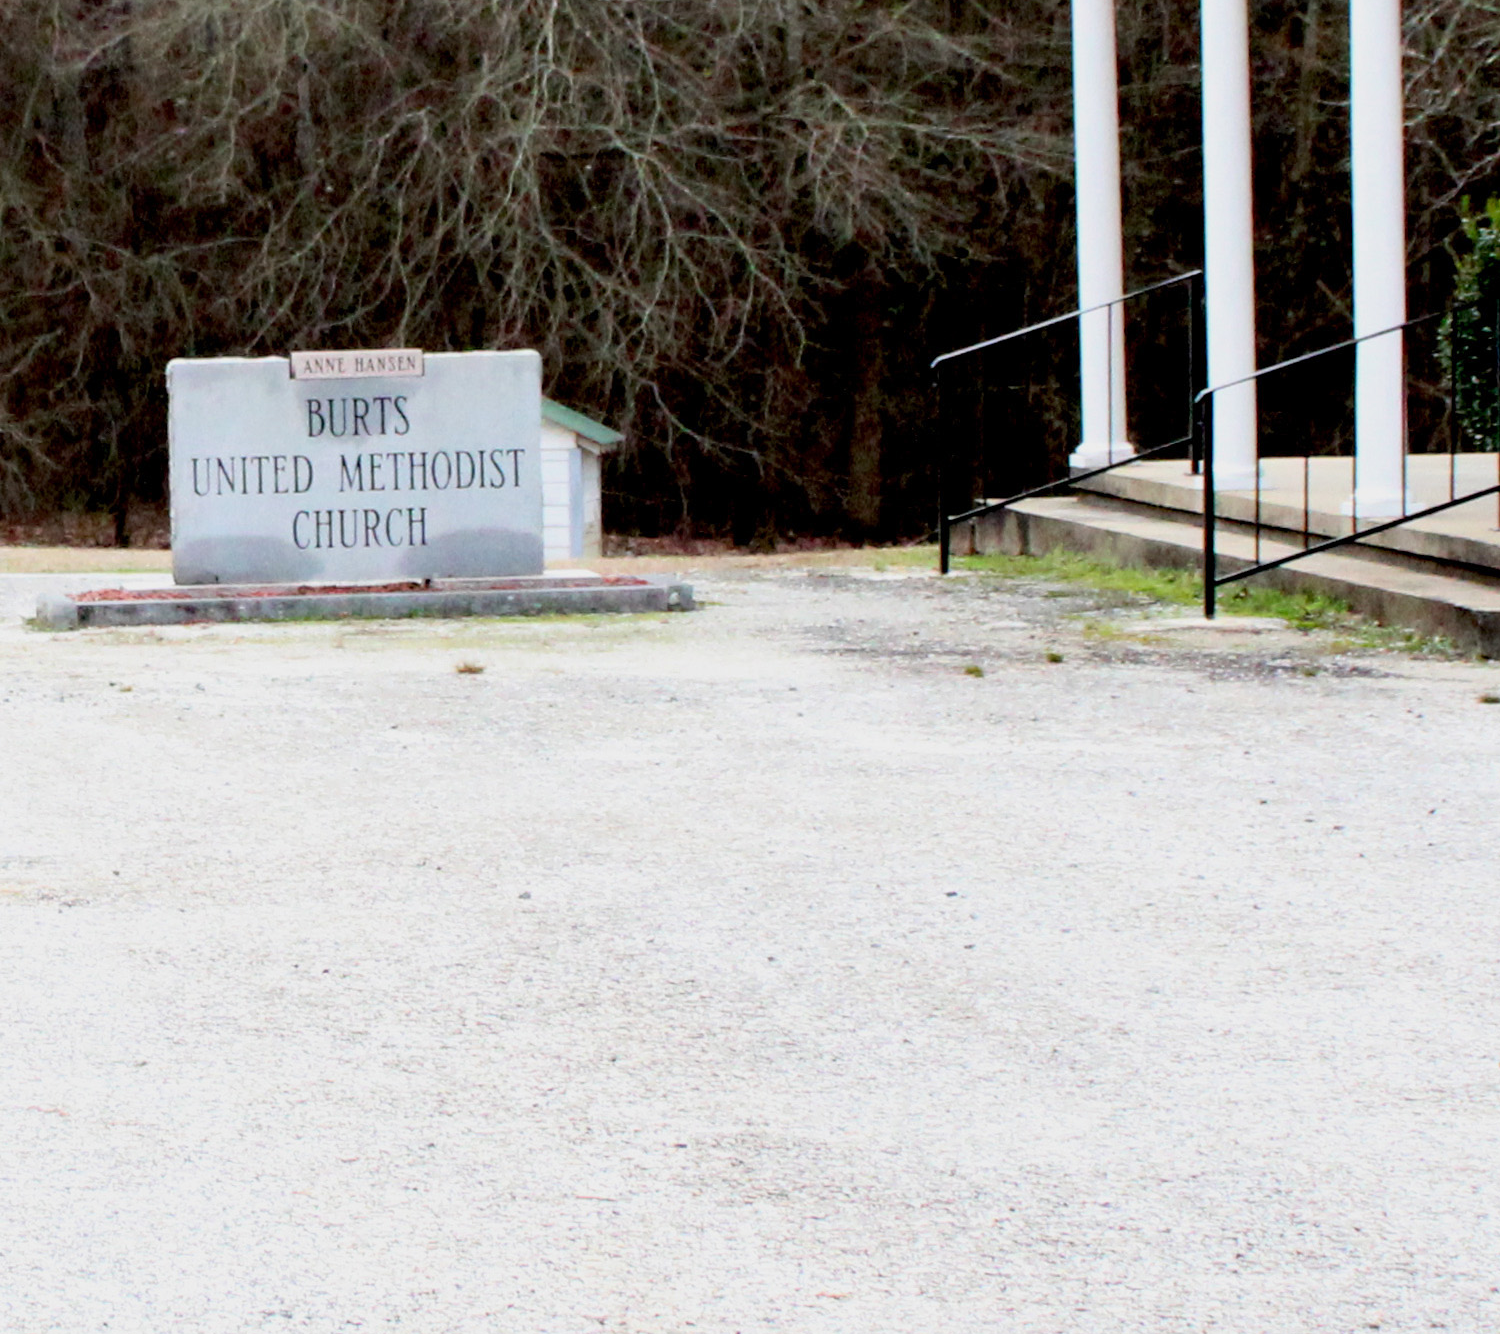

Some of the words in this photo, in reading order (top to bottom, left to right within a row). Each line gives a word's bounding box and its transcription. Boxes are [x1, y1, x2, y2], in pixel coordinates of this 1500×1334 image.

[304, 357, 345, 374] ANNE
[355, 355, 416, 372] HANSEN
[307, 395, 411, 437] BURTS
[191, 455, 314, 496] UNITED
[339, 449, 526, 492] METHODIST
[292, 507, 428, 549] CHURCH
